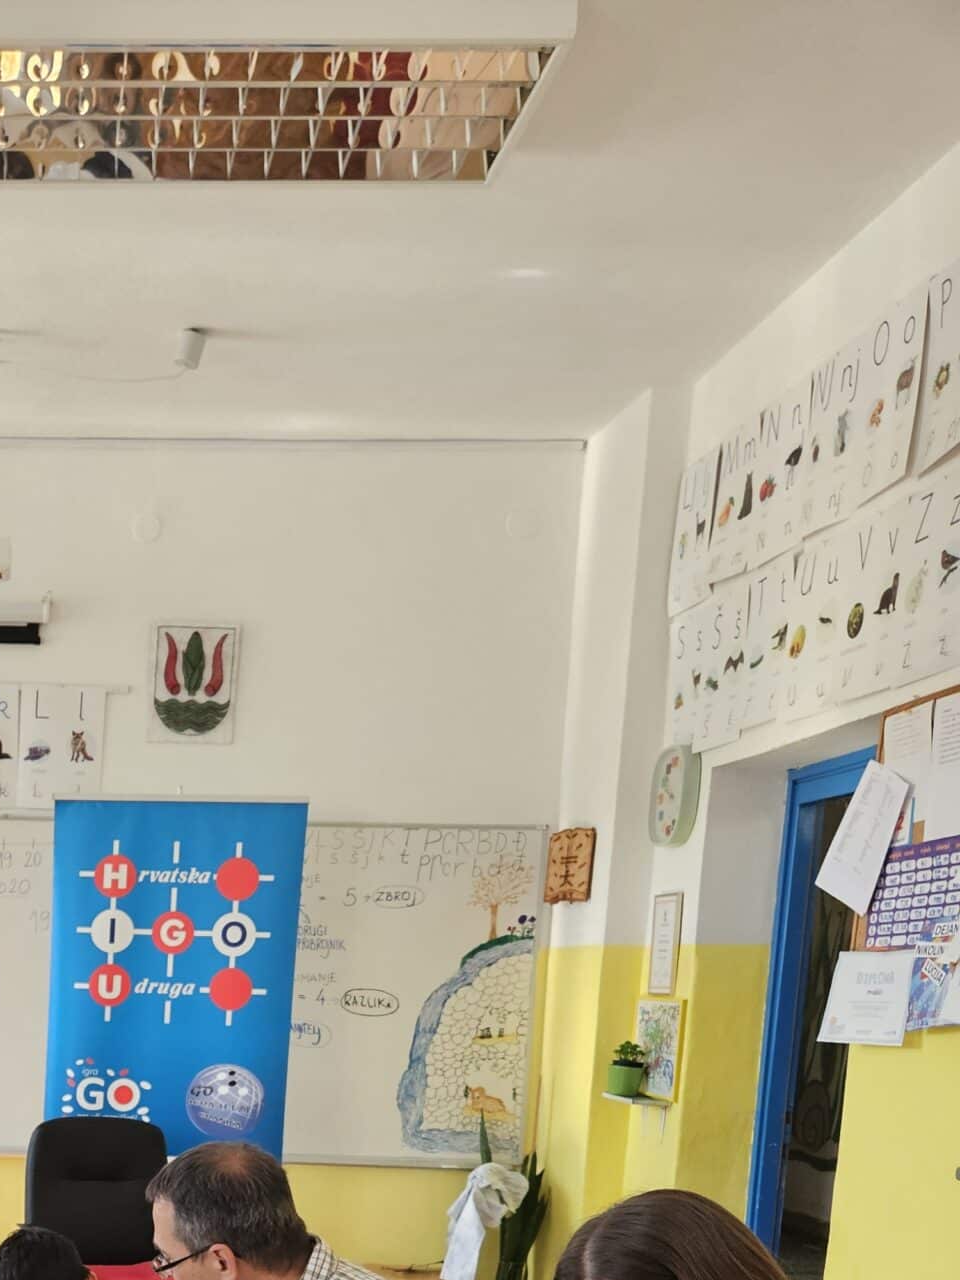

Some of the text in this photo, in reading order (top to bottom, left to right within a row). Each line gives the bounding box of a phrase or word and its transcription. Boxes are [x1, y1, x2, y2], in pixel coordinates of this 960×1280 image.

[873, 320, 890, 366] O
[858, 525, 873, 571] V
[34, 689, 50, 719] L
[75, 1076, 142, 1113] GO
